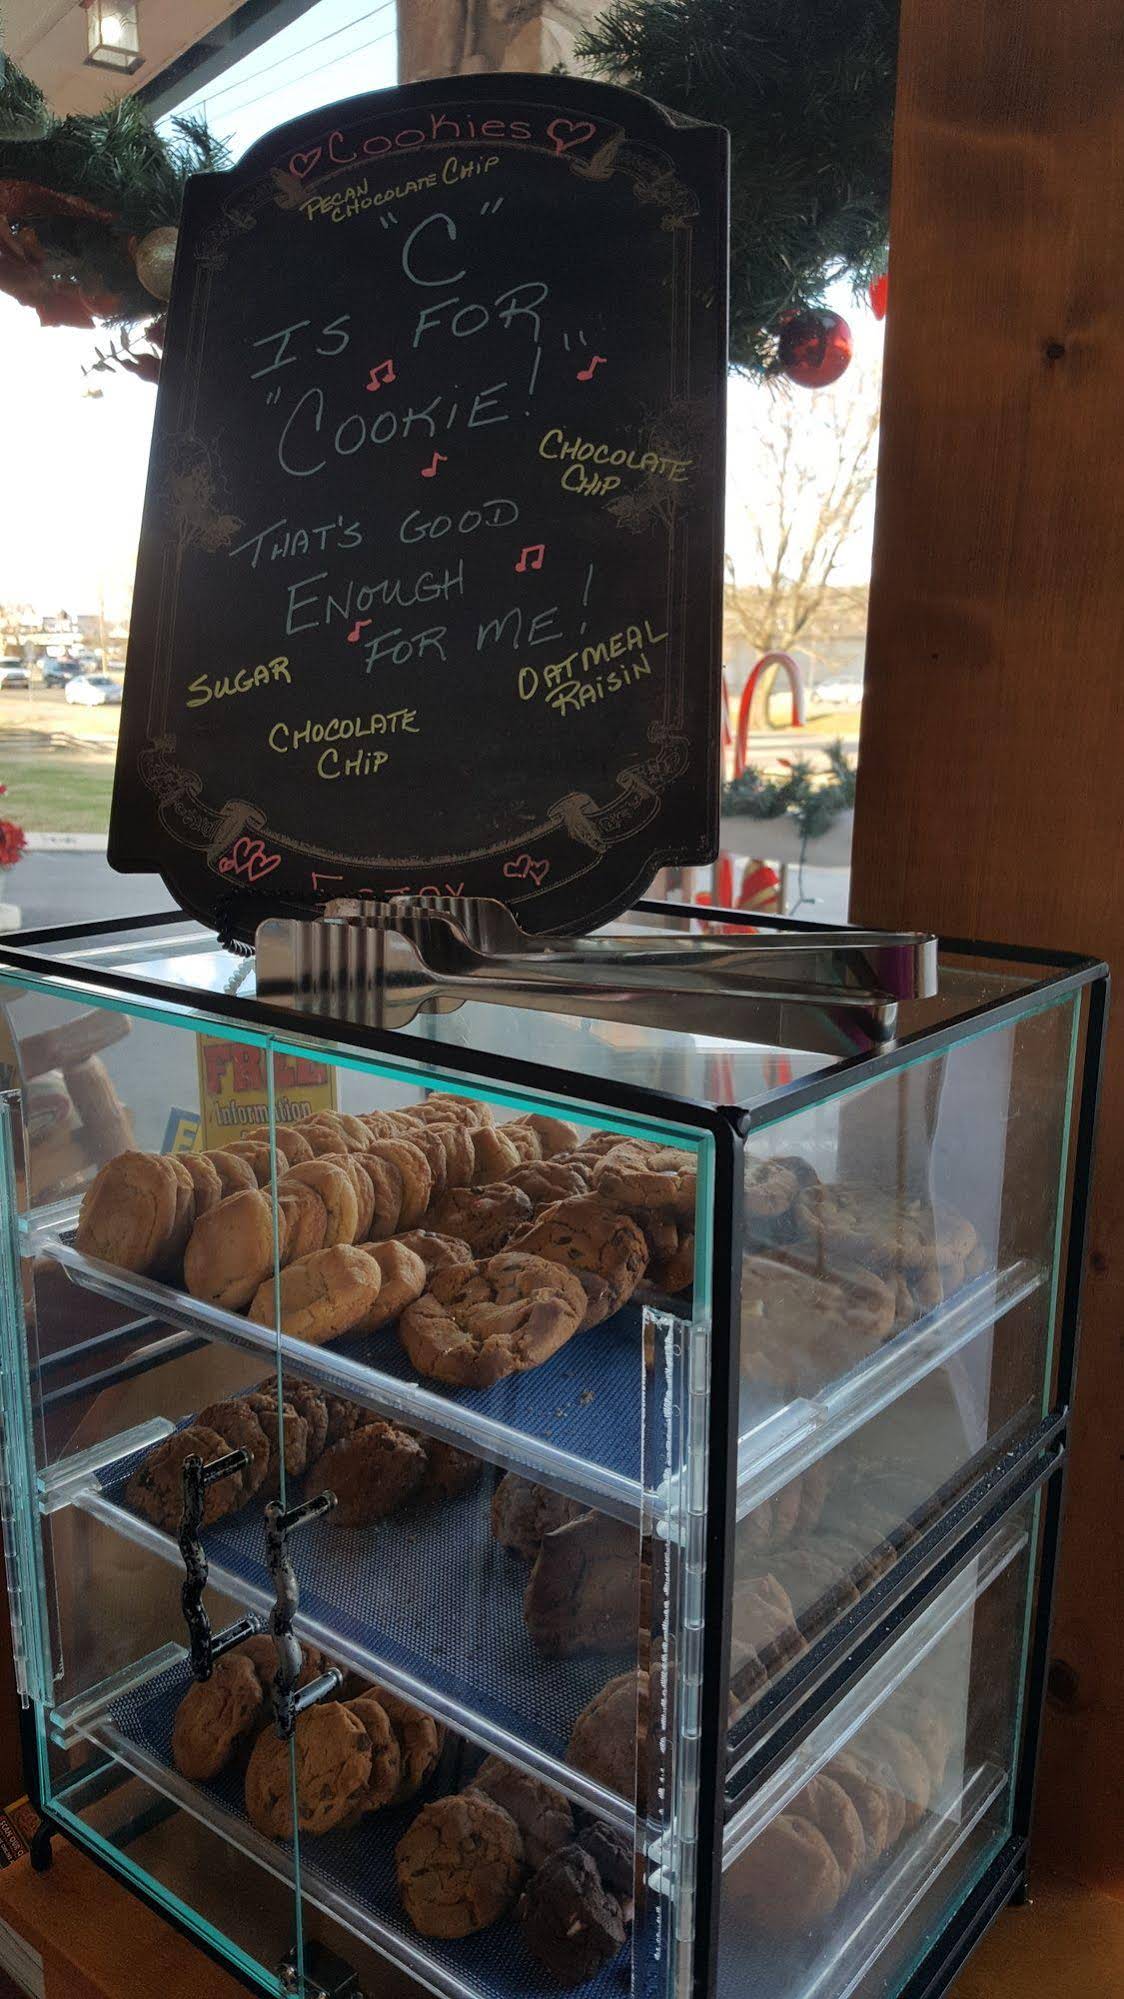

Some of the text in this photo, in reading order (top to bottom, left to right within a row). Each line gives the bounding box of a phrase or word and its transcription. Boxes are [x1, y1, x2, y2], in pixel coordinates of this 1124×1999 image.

[328, 112, 531, 163] Cookies
[299, 177, 369, 221] PECAN
[331, 173, 437, 223] CHOCOLATE
[250, 282, 549, 380] IS FOR
[538, 428, 693, 482] CHOCOLATE
[229, 499, 520, 569] THAT'S GOOD
[364, 626, 449, 674] FOR
[518, 619, 670, 702] OATMEAL
[186, 656, 292, 709] SUGAR
[268, 708, 420, 755] CHOCOLATE
